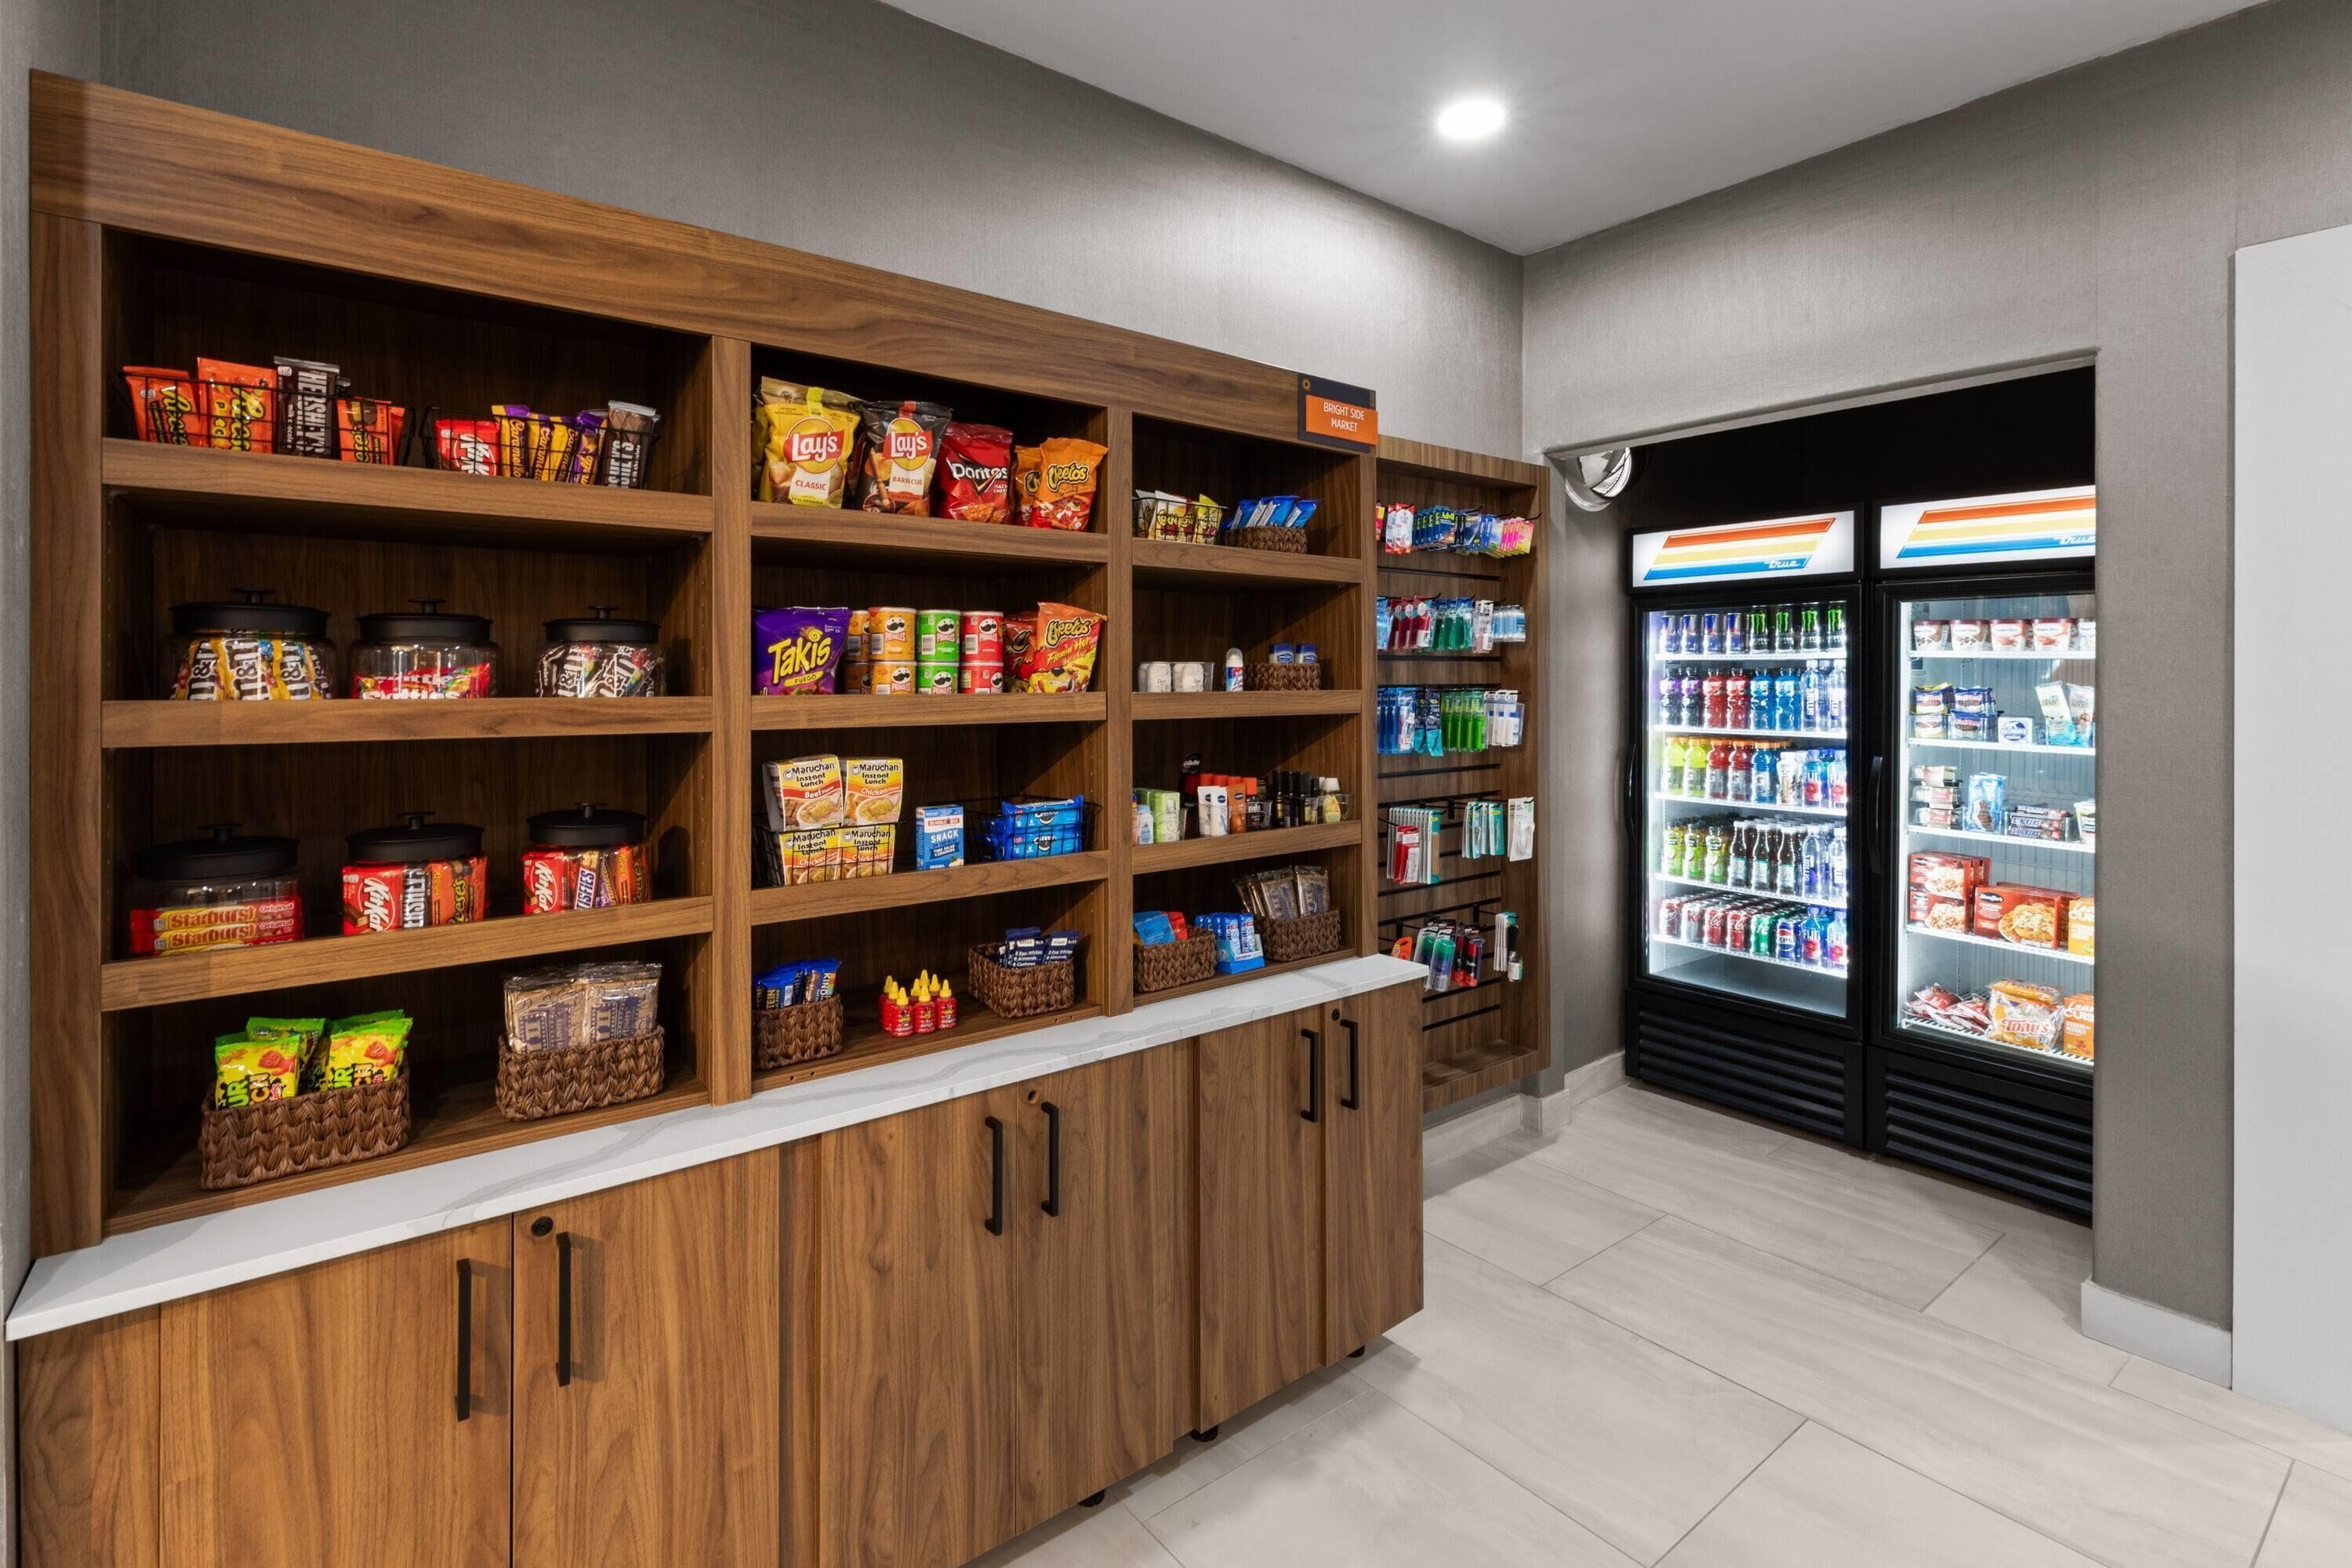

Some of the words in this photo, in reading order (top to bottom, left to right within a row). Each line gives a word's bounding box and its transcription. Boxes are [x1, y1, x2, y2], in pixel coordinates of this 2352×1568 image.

[1323, 401, 1348, 417] BRIGHT
[1350, 408, 1365, 420] SIDE
[1330, 418, 1358, 432] MARKET
[792, 431, 838, 463] Lay's
[891, 431, 927, 459] Lay's
[1047, 461, 1090, 492] Cheetos
[795, 480, 826, 491] CLASSIC
[1046, 617, 1091, 648] Cheetos
[768, 629, 832, 684] Takis
[794, 674, 818, 684] FUEGO
[793, 762, 835, 775] Maruchan
[859, 763, 898, 772] Maruchan
[797, 772, 826, 782] Instant
[804, 789, 822, 799] Beef
[862, 787, 888, 796] Chicken
[793, 829, 836, 843] Maruchan
[931, 829, 959, 844] SNACK
[798, 840, 826, 850] Instant
[168, 906, 257, 929] Starburst
[259, 902, 294, 913] Original
[169, 924, 257, 948] Starburst
[820, 972, 831, 996] KIND
